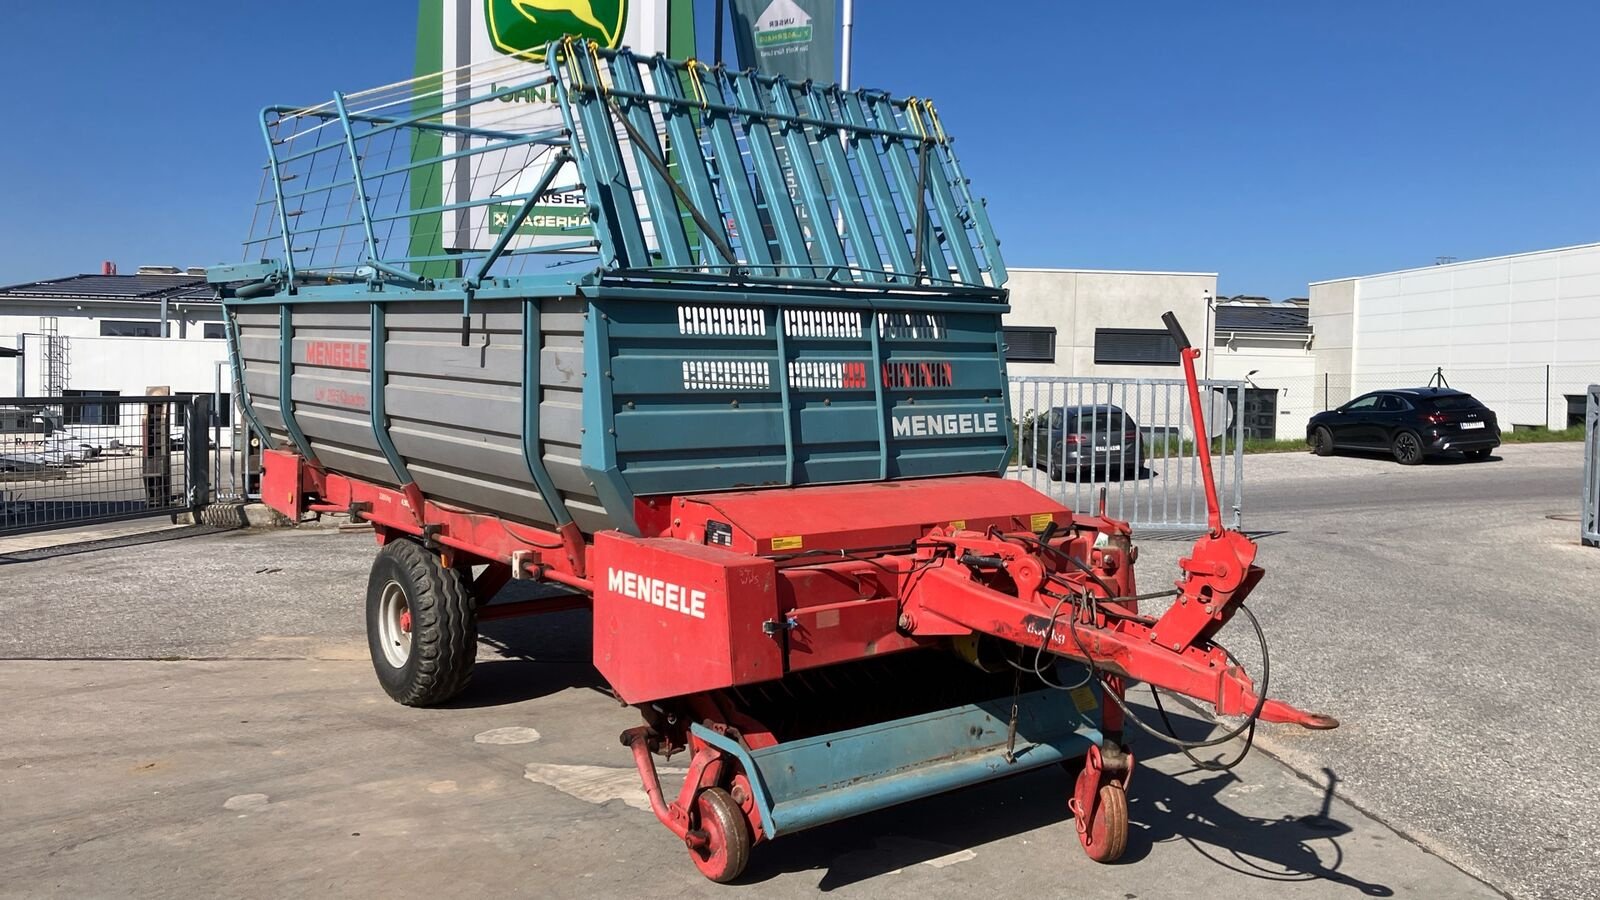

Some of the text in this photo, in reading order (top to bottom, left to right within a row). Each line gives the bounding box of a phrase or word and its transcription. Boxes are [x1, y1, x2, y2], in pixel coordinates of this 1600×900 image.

[536, 194, 586, 204] NSER
[512, 215, 590, 228] AGERHA
[305, 341, 368, 369] MENGELE
[892, 412, 998, 437] MENGELE
[608, 566, 706, 619] MENGELE
